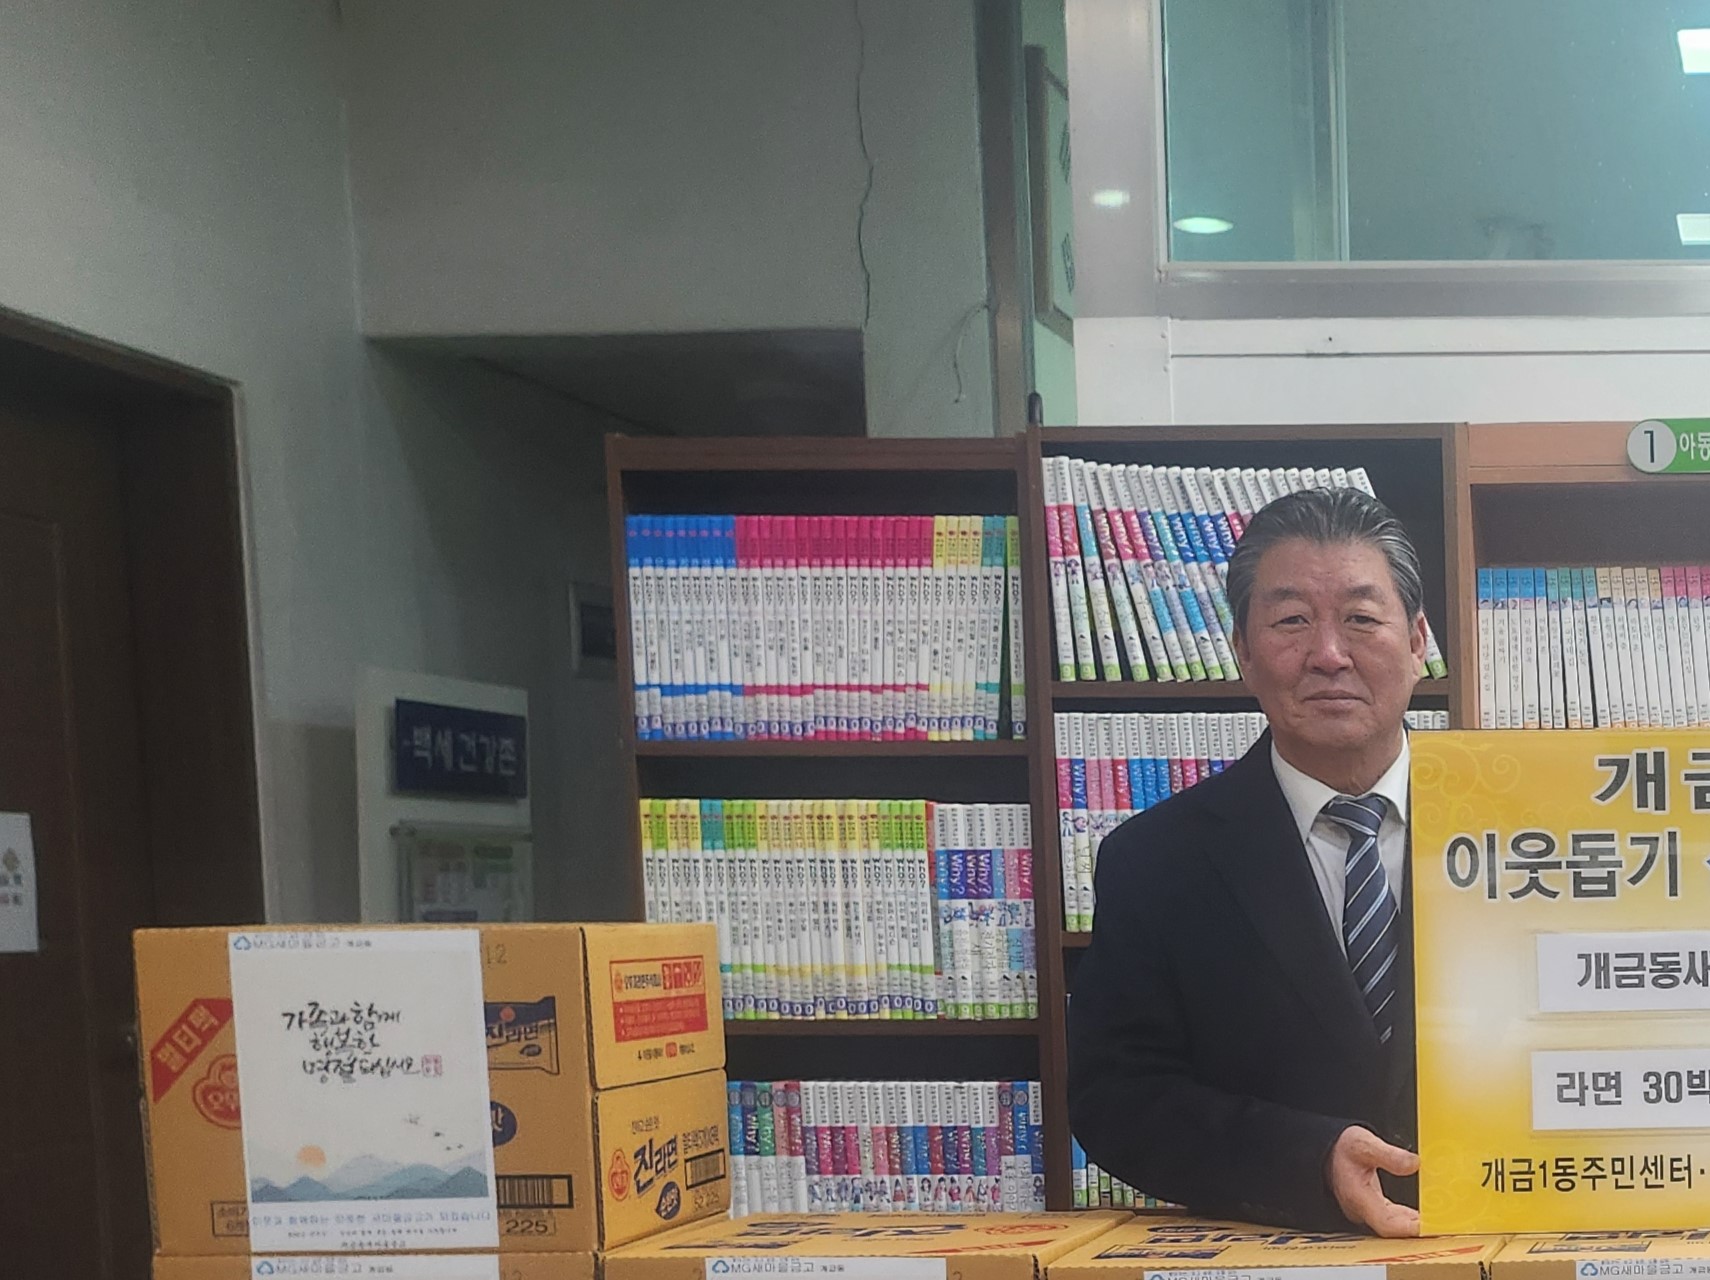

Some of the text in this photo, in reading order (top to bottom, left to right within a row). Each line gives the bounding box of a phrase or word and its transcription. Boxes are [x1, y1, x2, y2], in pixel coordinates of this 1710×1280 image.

[1644, 430, 1655, 463] 1
[1445, 830, 1680, 900] 이웃돕기
[309, 1027, 381, 1057] 행복한
[1556, 1071, 1622, 1106] 라면
